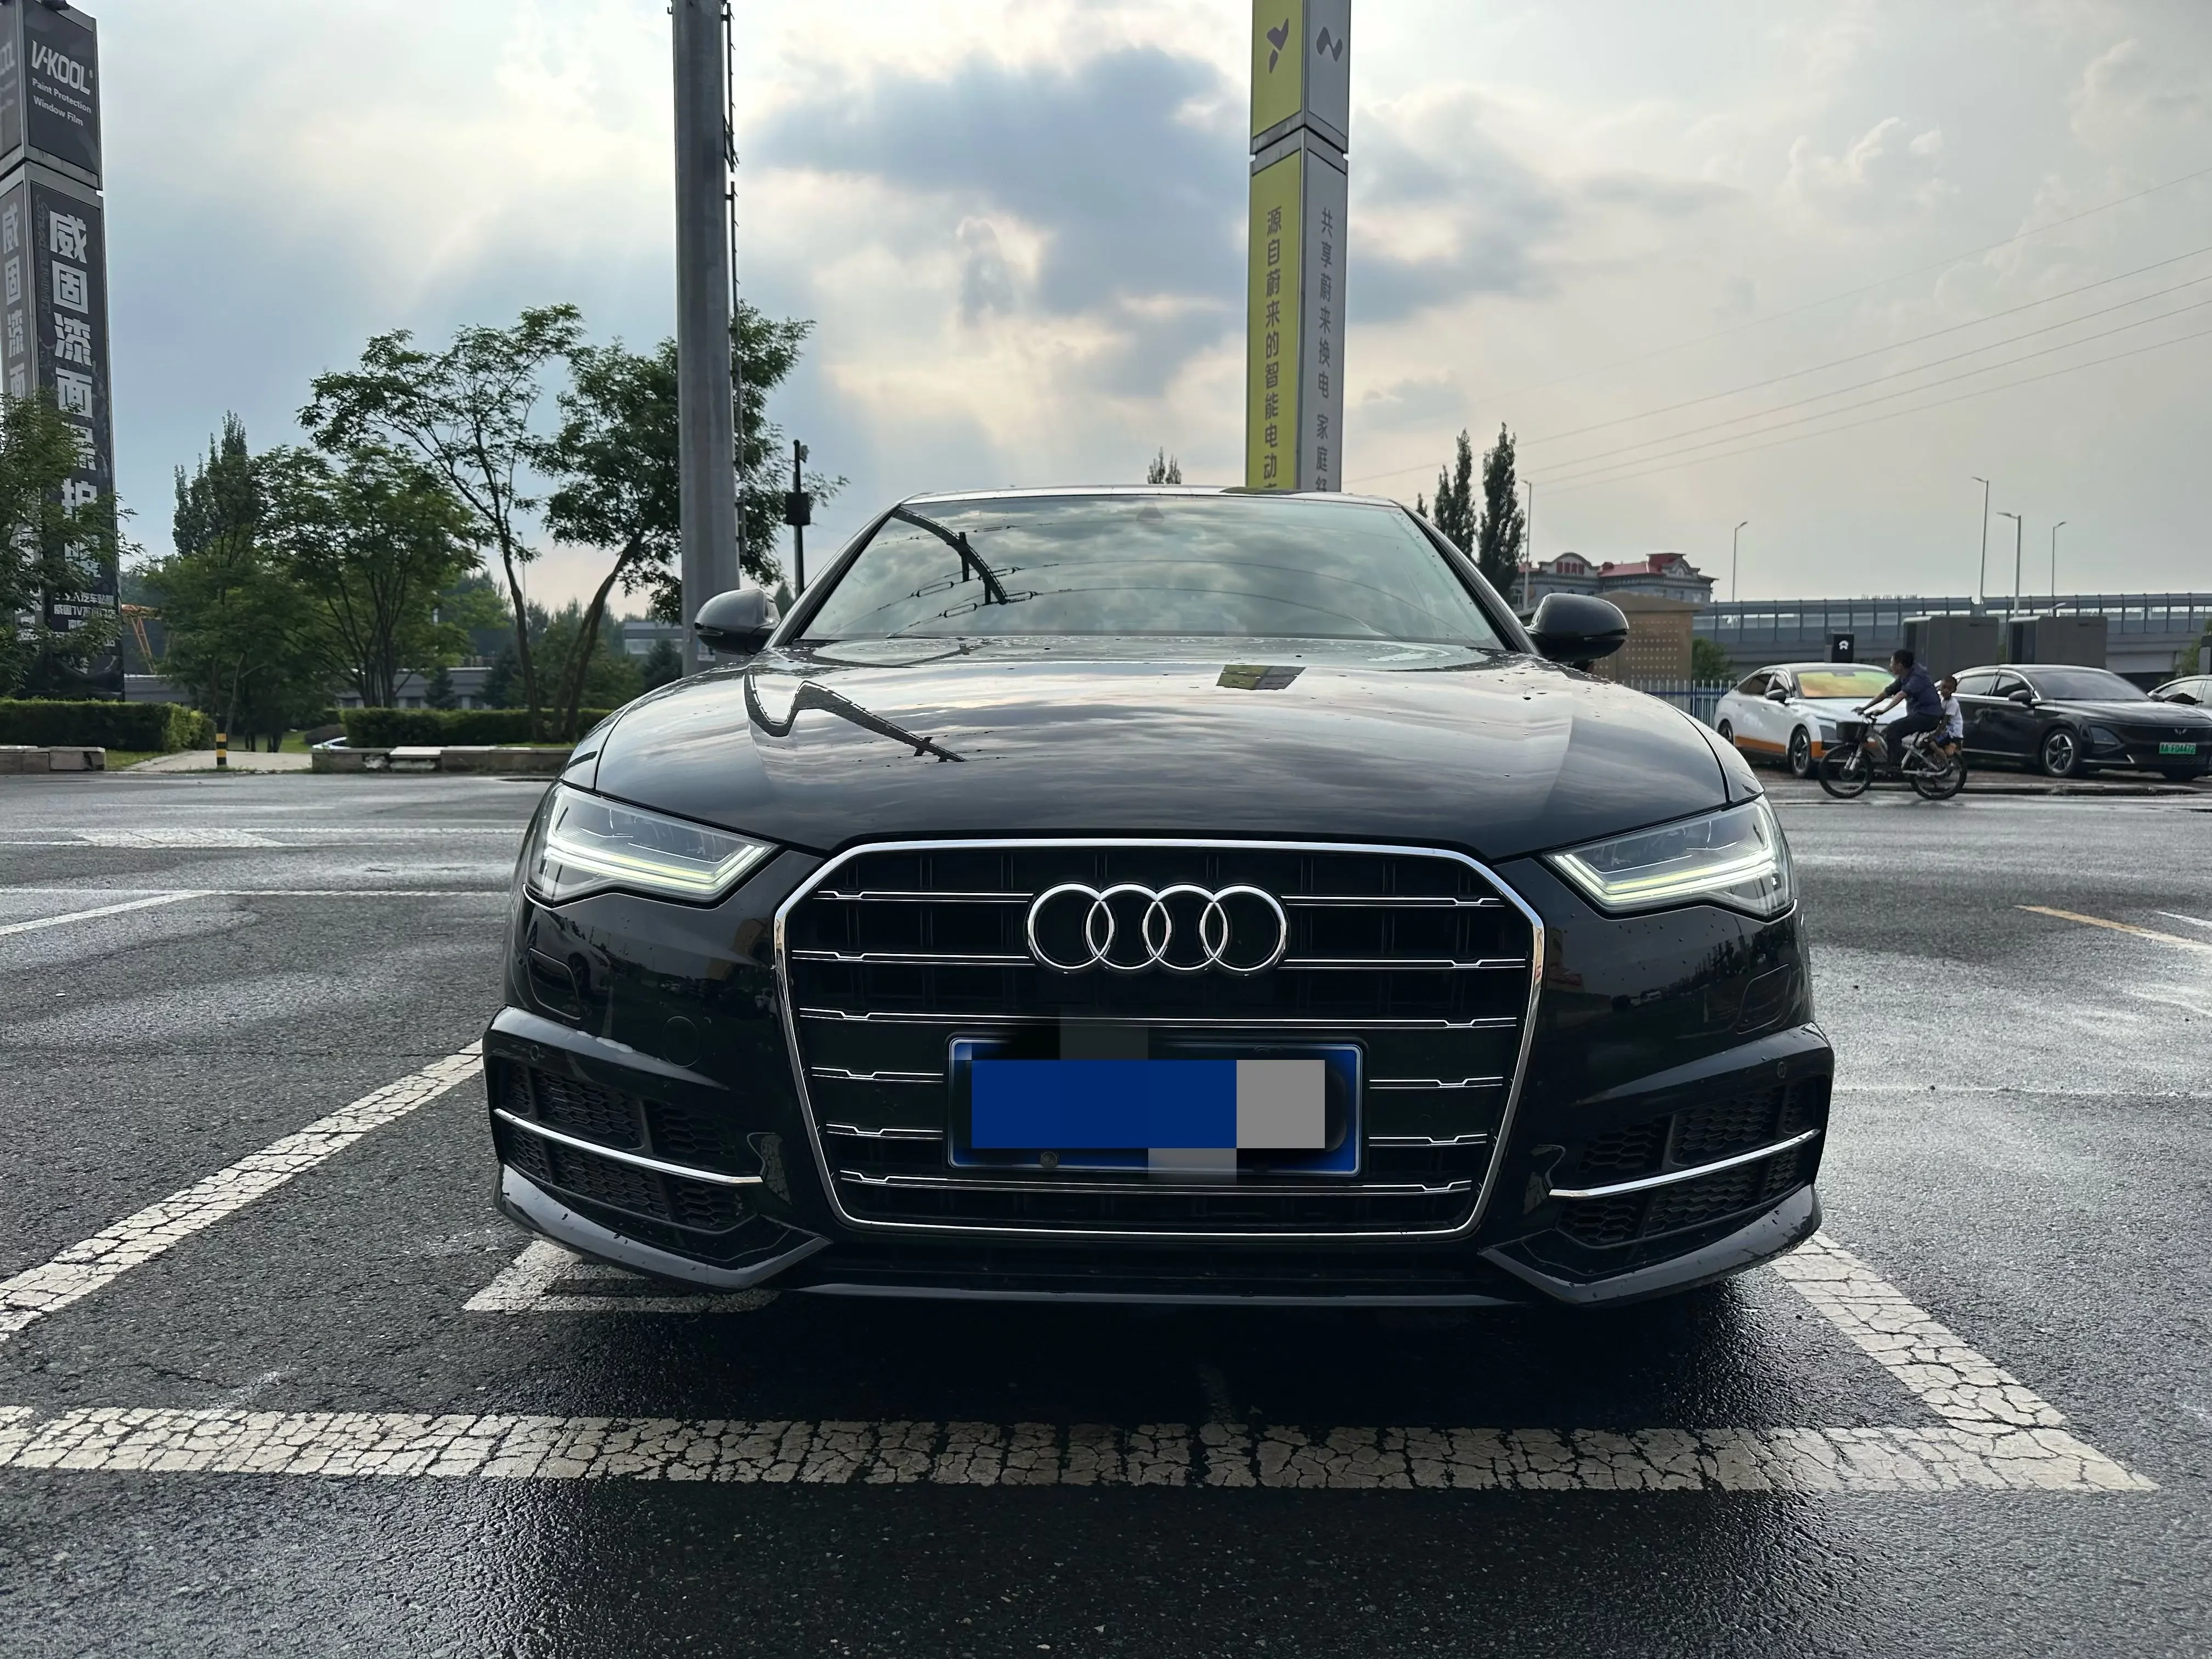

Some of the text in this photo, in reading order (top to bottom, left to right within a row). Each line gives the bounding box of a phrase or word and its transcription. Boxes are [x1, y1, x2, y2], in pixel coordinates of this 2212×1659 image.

[31, 40, 91, 95] V-KOOL
[32, 77, 53, 94] Paint
[54, 88, 92, 114] Protection
[33, 95, 66, 117] Window
[67, 111, 83, 126] Film
[1263, 206, 1282, 488] 源自蔚来的智能电动
